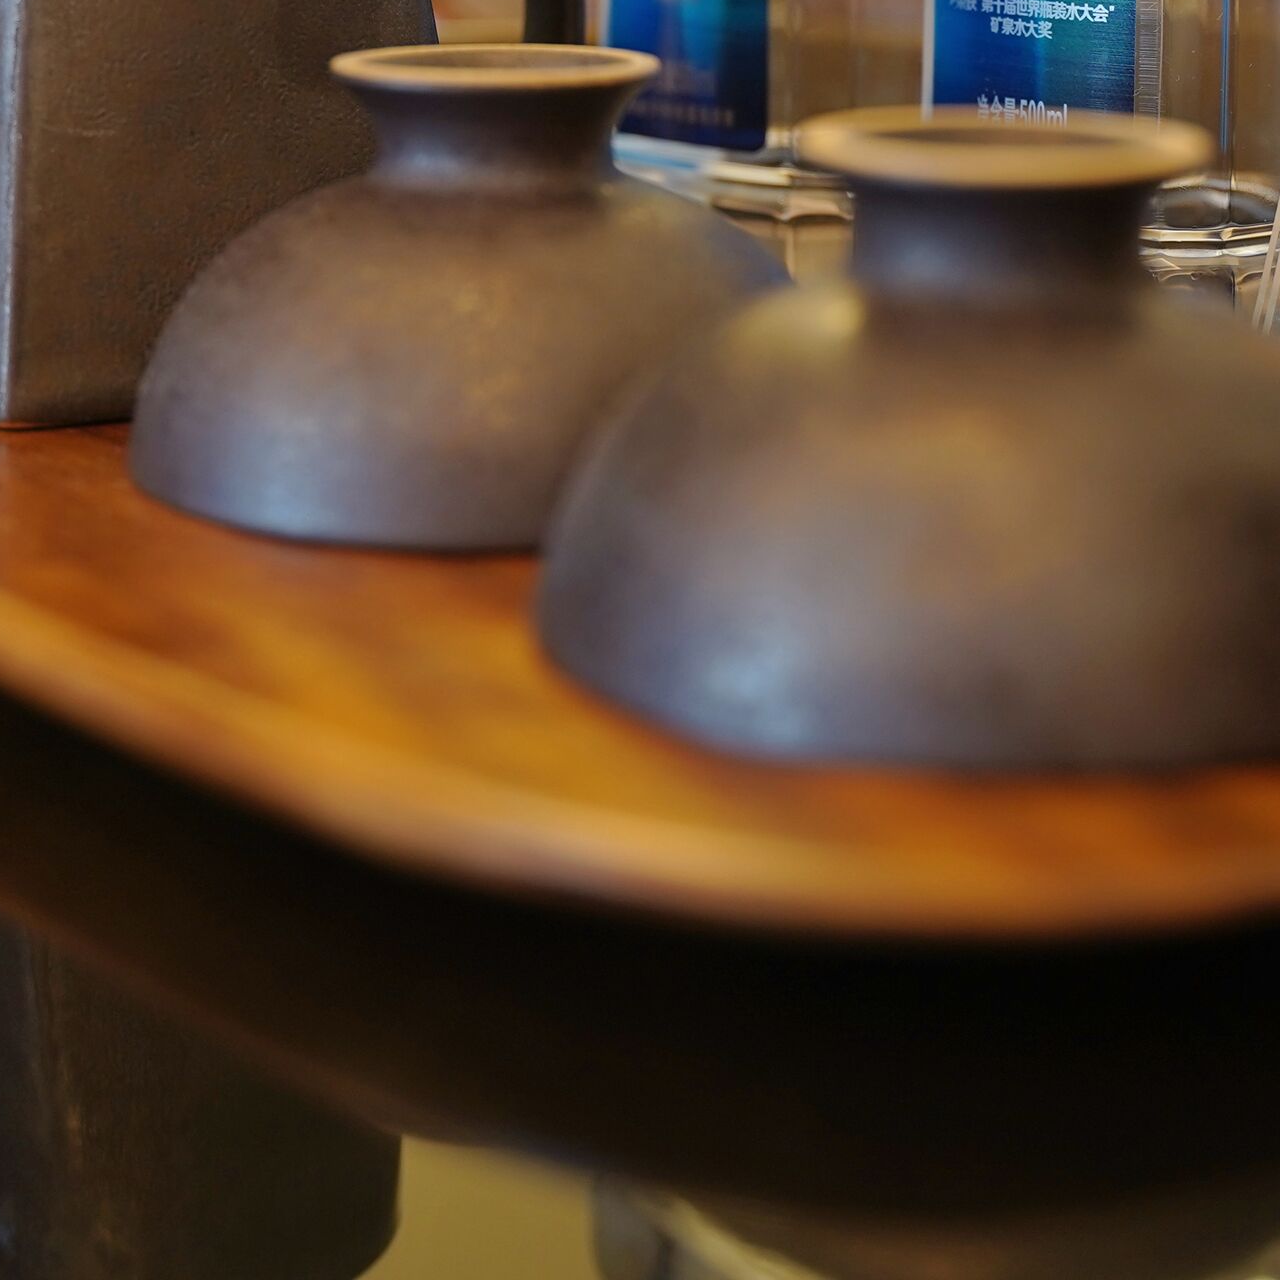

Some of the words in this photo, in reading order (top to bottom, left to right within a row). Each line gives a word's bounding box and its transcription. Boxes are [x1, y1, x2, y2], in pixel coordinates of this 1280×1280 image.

[990, 16, 1053, 39] 矿泉水大奖
